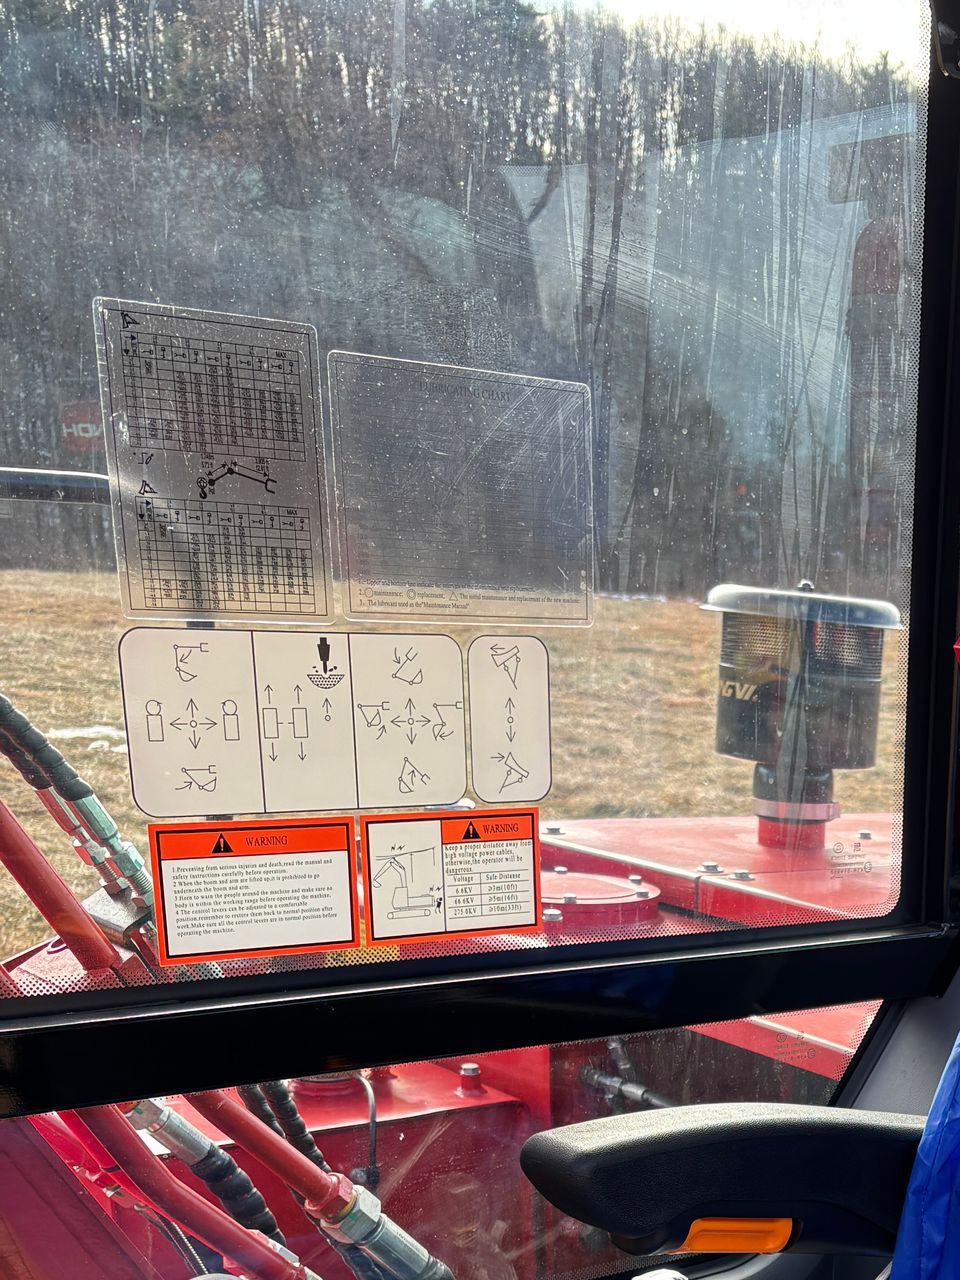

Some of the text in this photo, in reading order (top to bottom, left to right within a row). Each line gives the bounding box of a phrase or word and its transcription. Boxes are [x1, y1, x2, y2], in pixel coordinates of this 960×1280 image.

[275, 350, 287, 358] MAX
[419, 380, 512, 402] LUBRICATING CHART
[286, 508, 298, 516] MAX
[482, 823, 519, 834] WARNING
[246, 836, 288, 847] WARNING
[458, 851, 478, 859] voltage
[479, 850, 495, 858] power
[482, 857, 503, 865] operator
[238, 862, 257, 870] injuries
[189, 871, 220, 879] instructions
[453, 875, 474, 884] Voltage
[485, 873, 498, 881] Safe
[222, 898, 244, 906] working
[177, 929, 202, 937] operating
